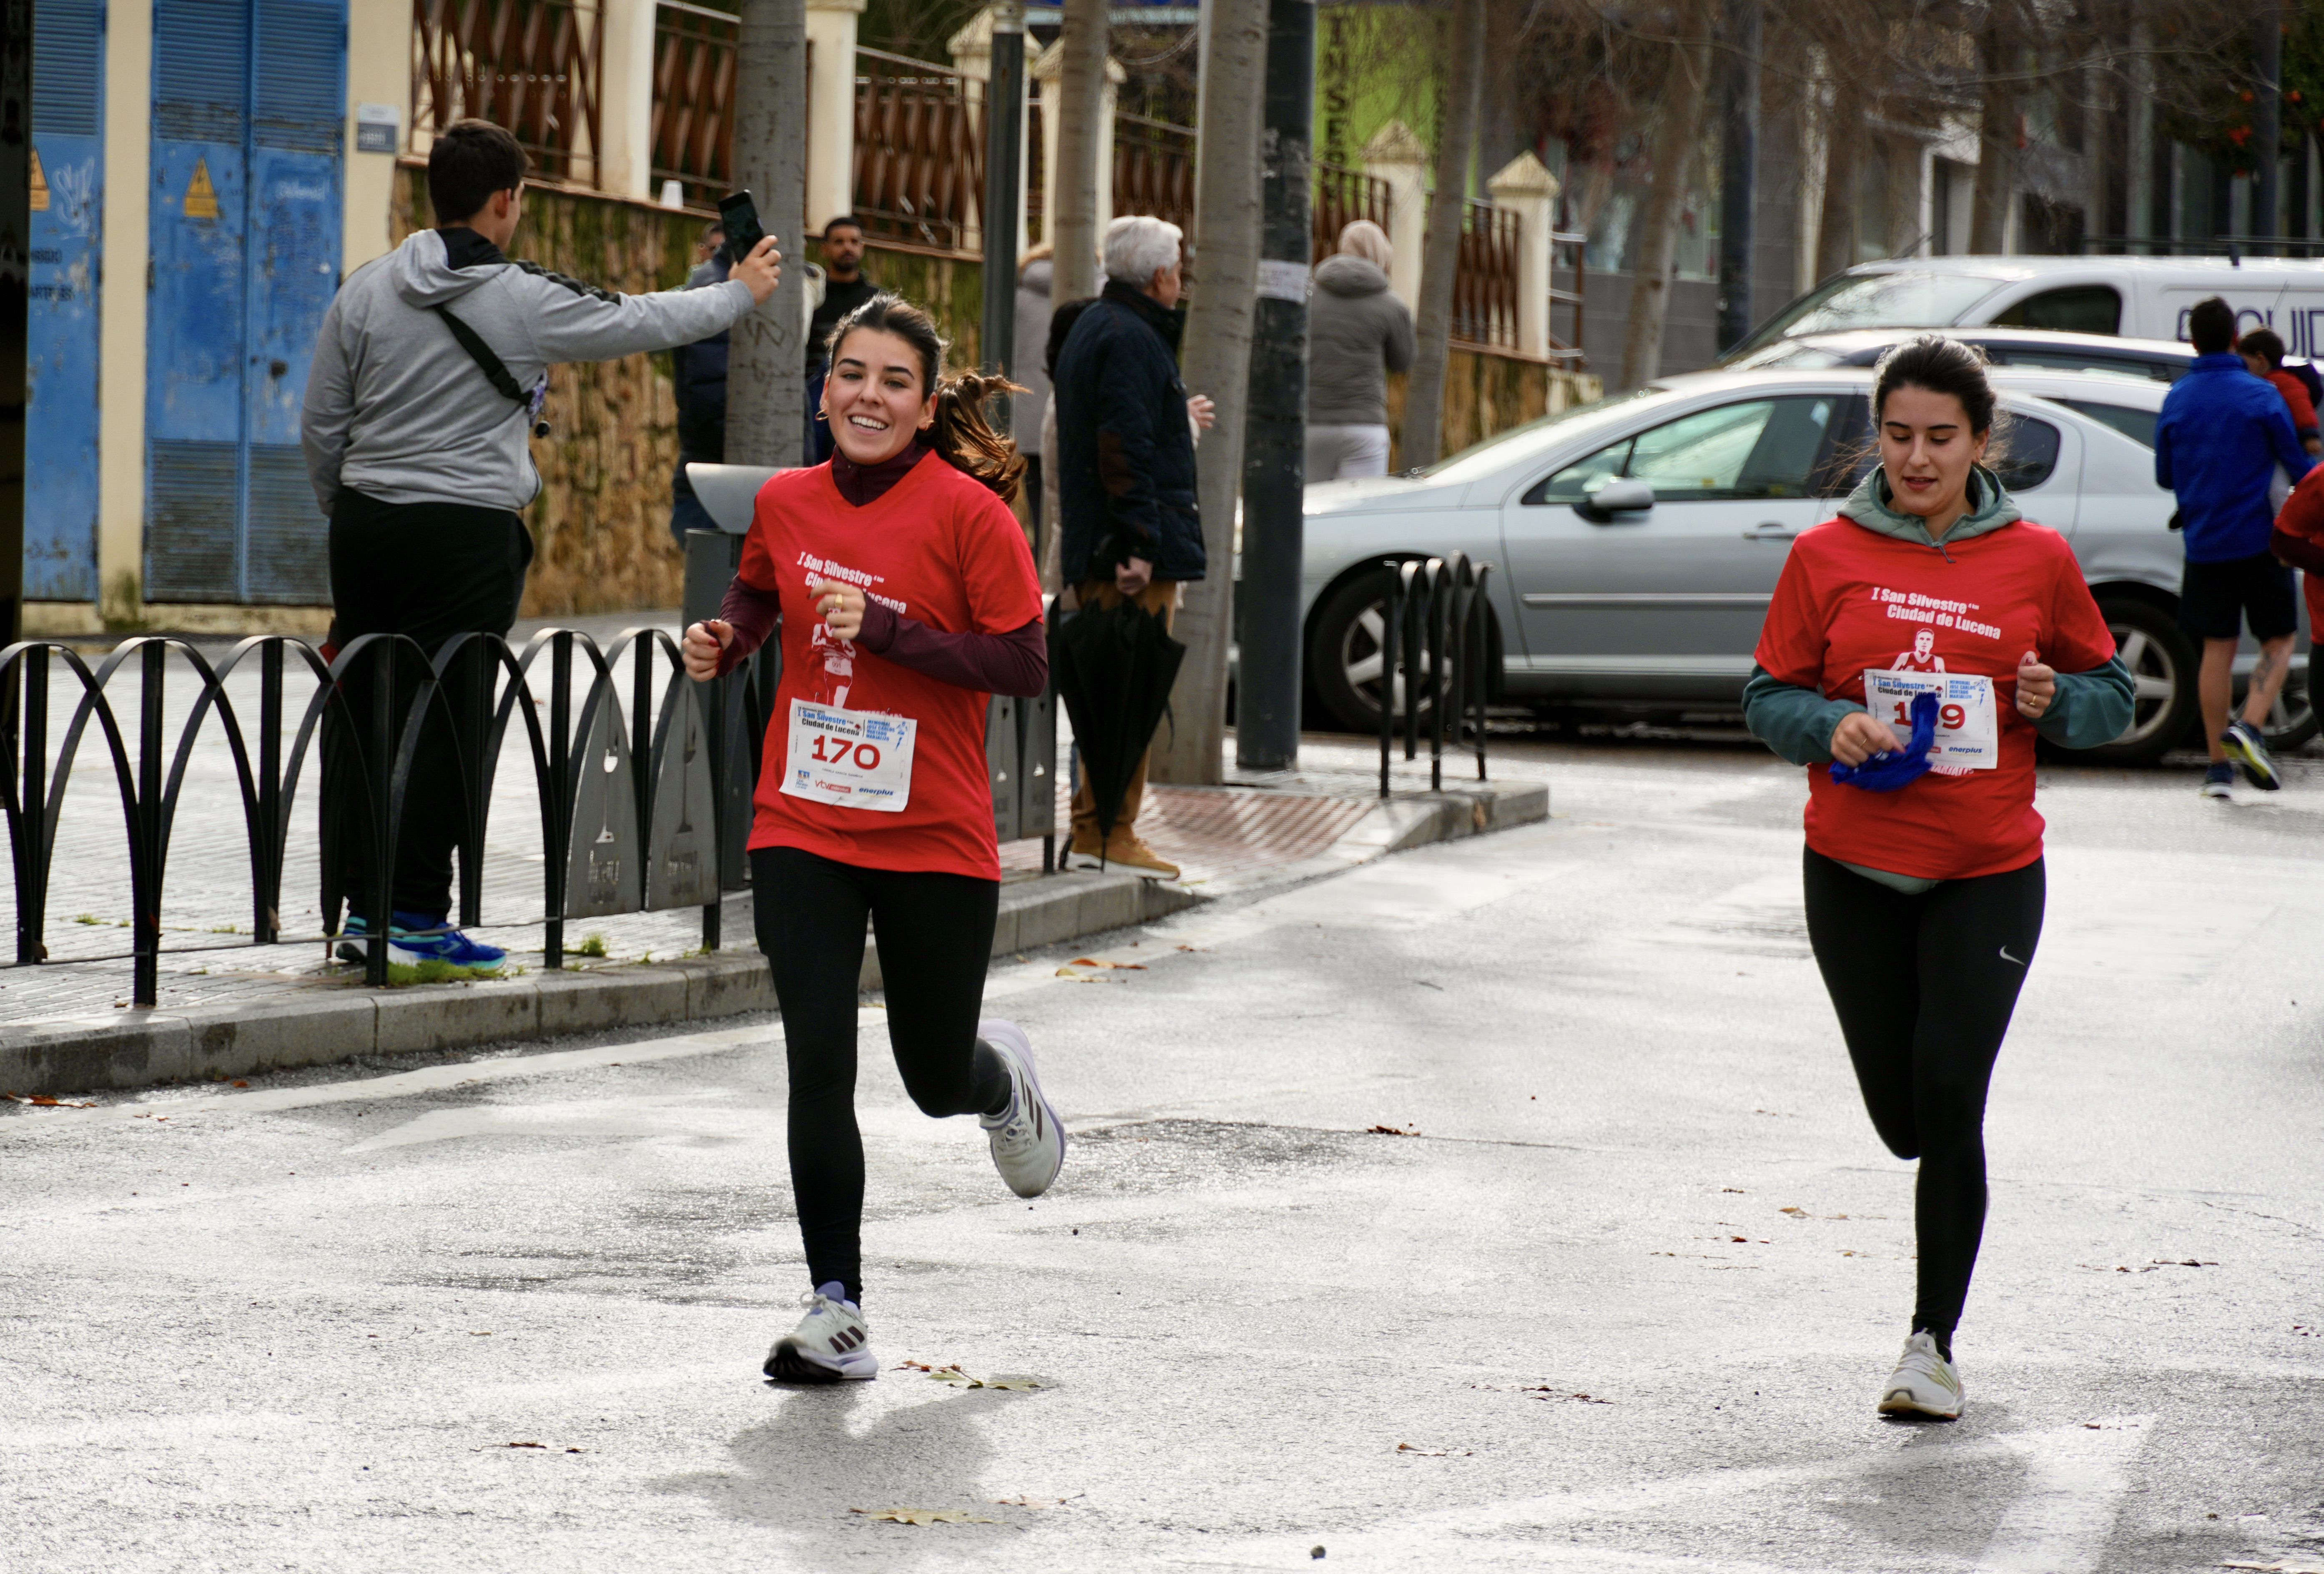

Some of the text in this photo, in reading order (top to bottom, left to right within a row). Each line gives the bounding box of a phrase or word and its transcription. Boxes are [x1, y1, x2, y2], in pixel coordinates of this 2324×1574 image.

[797, 551, 806, 565] I
[803, 554, 823, 572] San
[823, 559, 872, 587] Silvestre
[1871, 587, 1880, 600] I
[1881, 588, 1906, 604] San
[1908, 592, 1967, 614] Silvestre
[1887, 604, 2001, 640] Ciudad de Lucena
[1878, 687, 1902, 695] Ciudad
[1892, 680, 1925, 689] Silvestre
[803, 709, 815, 719] San
[817, 712, 846, 725] Silvestre
[1894, 702, 1965, 729] 19
[802, 718, 824, 729] Ciudad
[835, 725, 860, 736] Lucena
[811, 734, 881, 770] 170
[859, 787, 894, 796] enerplus
